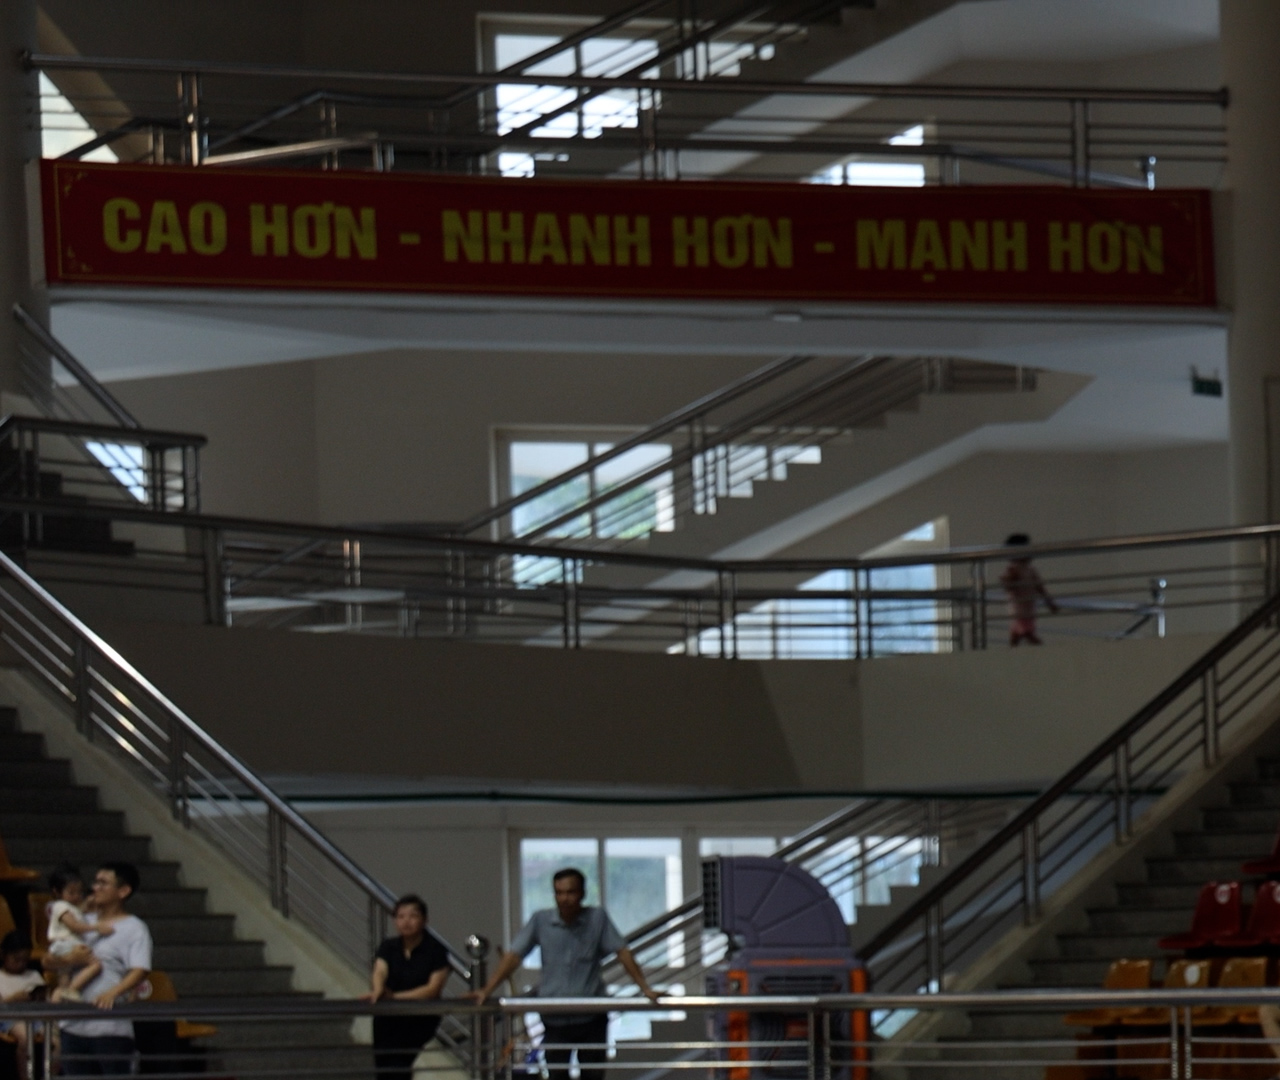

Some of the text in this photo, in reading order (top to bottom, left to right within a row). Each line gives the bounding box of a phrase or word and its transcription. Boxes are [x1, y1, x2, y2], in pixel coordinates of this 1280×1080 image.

[103, 196, 1164, 284] CAO HƠN - NHANH HƠN - MẠNH HƠN
